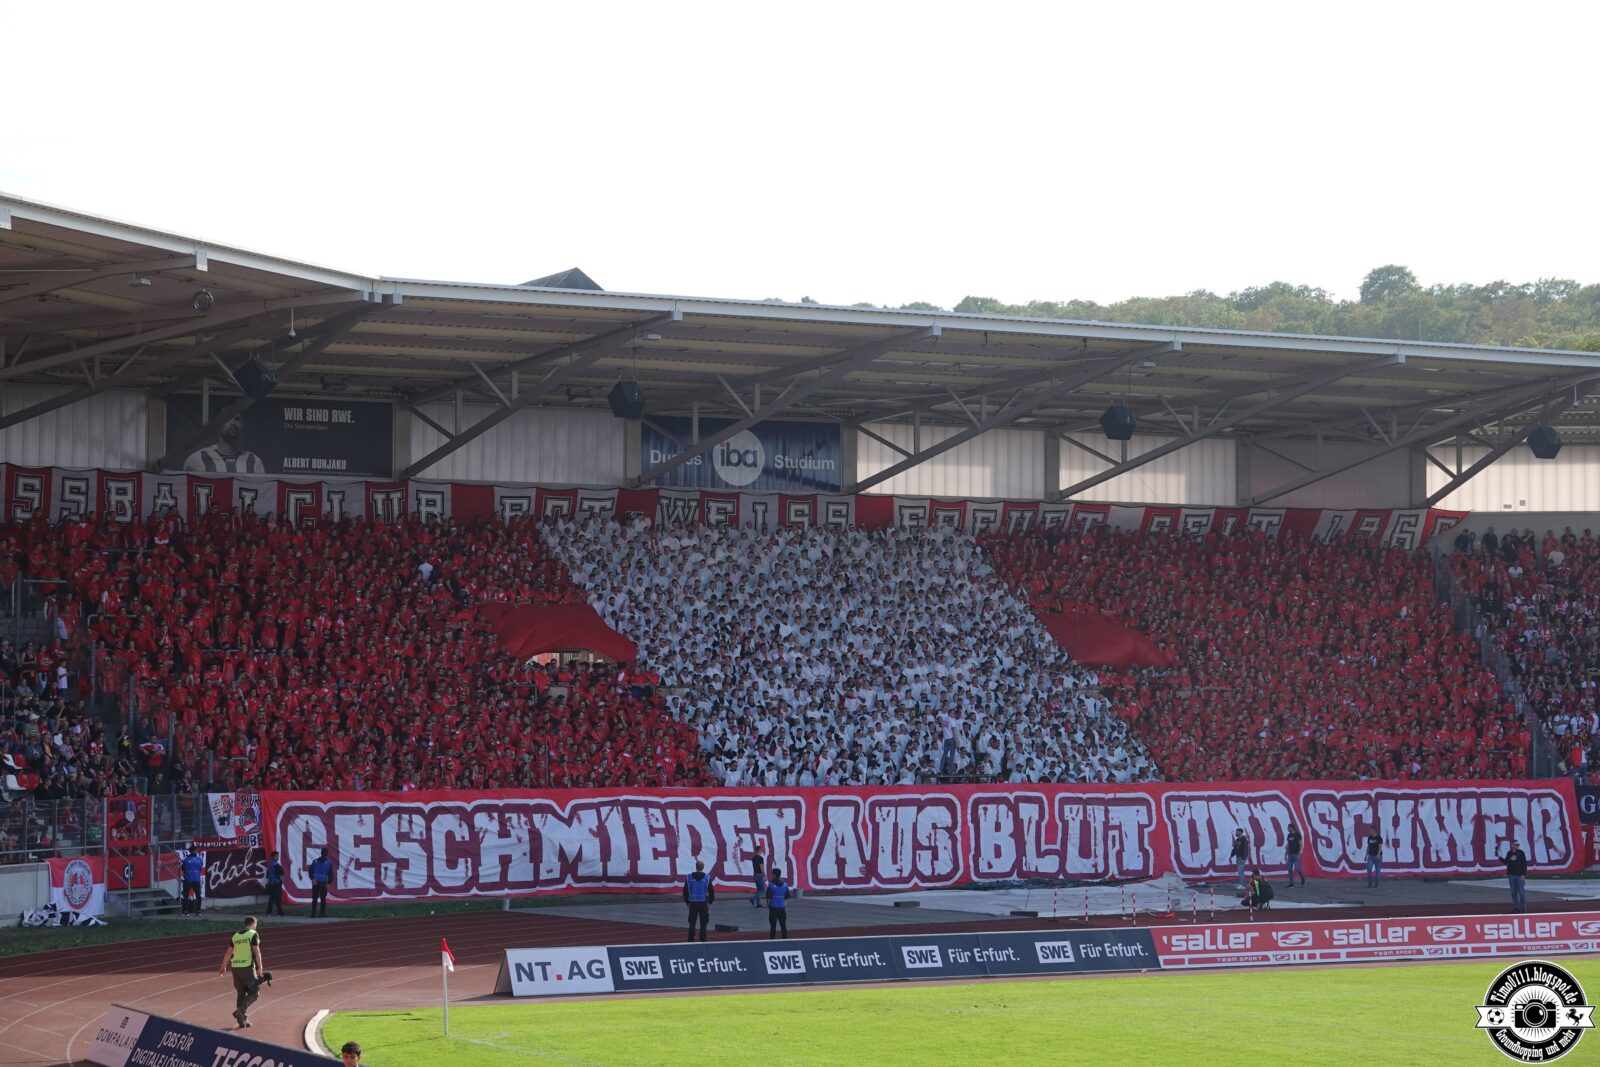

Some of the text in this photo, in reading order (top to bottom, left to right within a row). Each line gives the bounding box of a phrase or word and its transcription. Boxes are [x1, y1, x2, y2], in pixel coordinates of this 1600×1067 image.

[284, 407, 355, 424] WIR SIND RWE.
[283, 457, 347, 470] ALBERT BUNJAKU
[650, 450, 703, 466] Dues
[720, 440, 758, 468] iba
[774, 454, 835, 471] Studium
[286, 804, 797, 890] GESCHMIEDET
[816, 804, 955, 880] AUS
[977, 802, 1149, 875] BLUT
[1169, 800, 1292, 868] UND
[769, 950, 887, 971] SWE Für Erfurt.
[906, 945, 1021, 965] SWE Für Erfurt.
[1039, 941, 1149, 960] SWE Für Erfurt.
[625, 956, 748, 976] SWE Für Erfurt.
[96, 1028, 138, 1050] DOMPALAIS
[157, 1030, 195, 1052] JOBS FÜR
